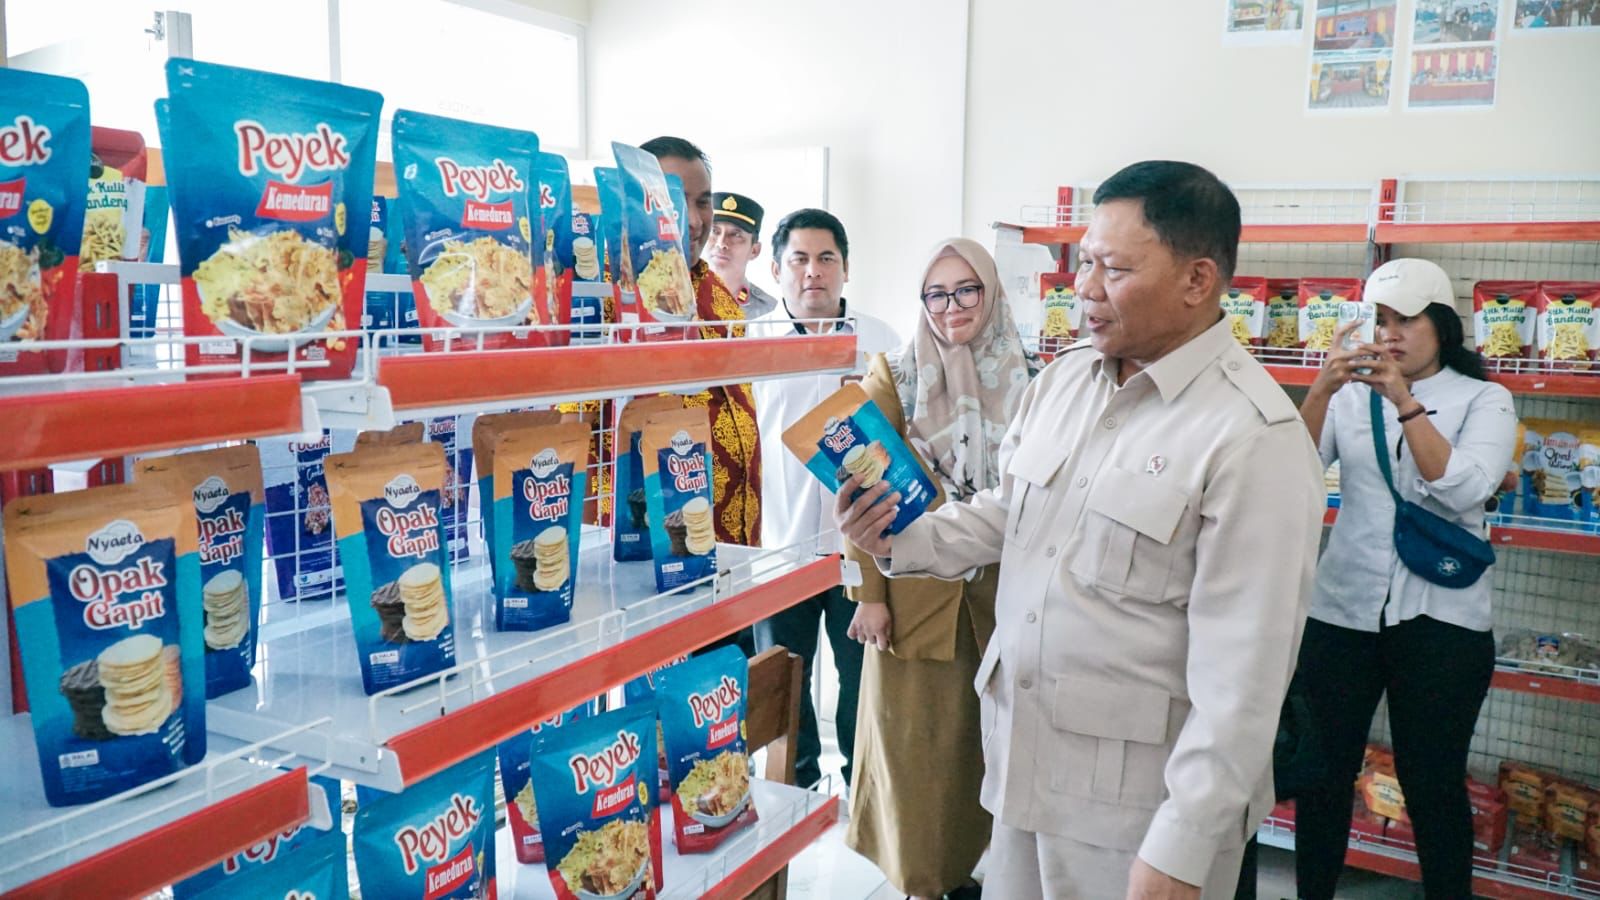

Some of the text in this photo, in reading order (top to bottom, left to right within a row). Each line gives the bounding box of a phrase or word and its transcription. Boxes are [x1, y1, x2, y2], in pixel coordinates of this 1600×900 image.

[234, 121, 351, 183] Peyek
[436, 158, 523, 200] Peyek
[87, 195, 128, 212] andeng
[265, 186, 329, 212] Kemeduran
[467, 203, 513, 224] Kemeduran
[667, 452, 704, 477] Opak
[384, 484, 421, 499] Nyaeta
[523, 474, 570, 504] Opak
[674, 472, 708, 494] Gapit
[376, 503, 439, 537] Opak
[529, 497, 569, 522] Gapit
[198, 506, 246, 544] pak
[87, 532, 144, 552] Nyaeta
[387, 529, 440, 559] Gapit
[69, 556, 168, 602] Opak
[84, 590, 165, 630] Gapit
[687, 674, 742, 729] Peyek
[569, 729, 641, 795] Peyek
[596, 783, 635, 812] Kemeduran
[394, 793, 481, 876] Peyek
[428, 855, 474, 894] Kemeduran
